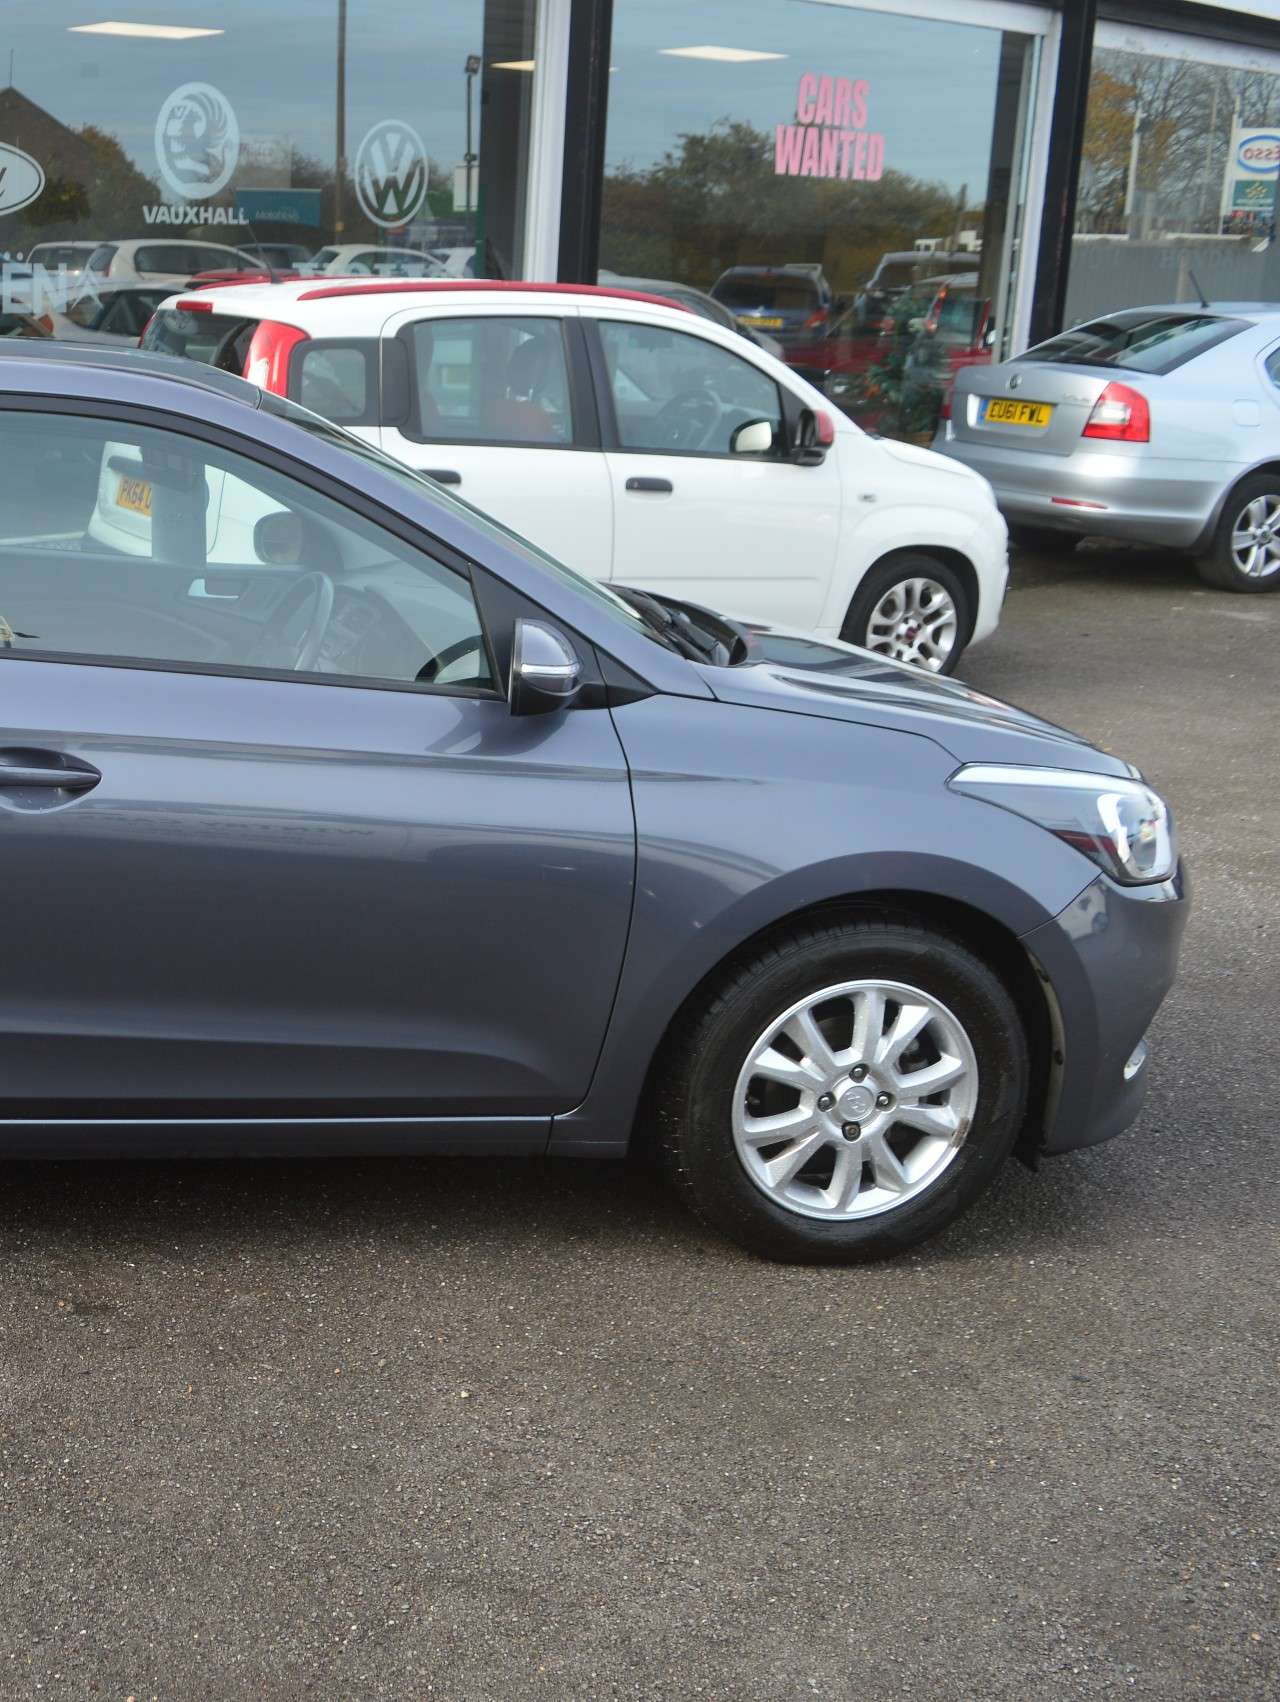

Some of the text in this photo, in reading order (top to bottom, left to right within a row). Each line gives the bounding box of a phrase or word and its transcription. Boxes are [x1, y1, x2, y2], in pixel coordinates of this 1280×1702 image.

[797, 72, 870, 129] CARS
[775, 123, 885, 181] WANTED
[142, 205, 250, 225] VAUXHALL
